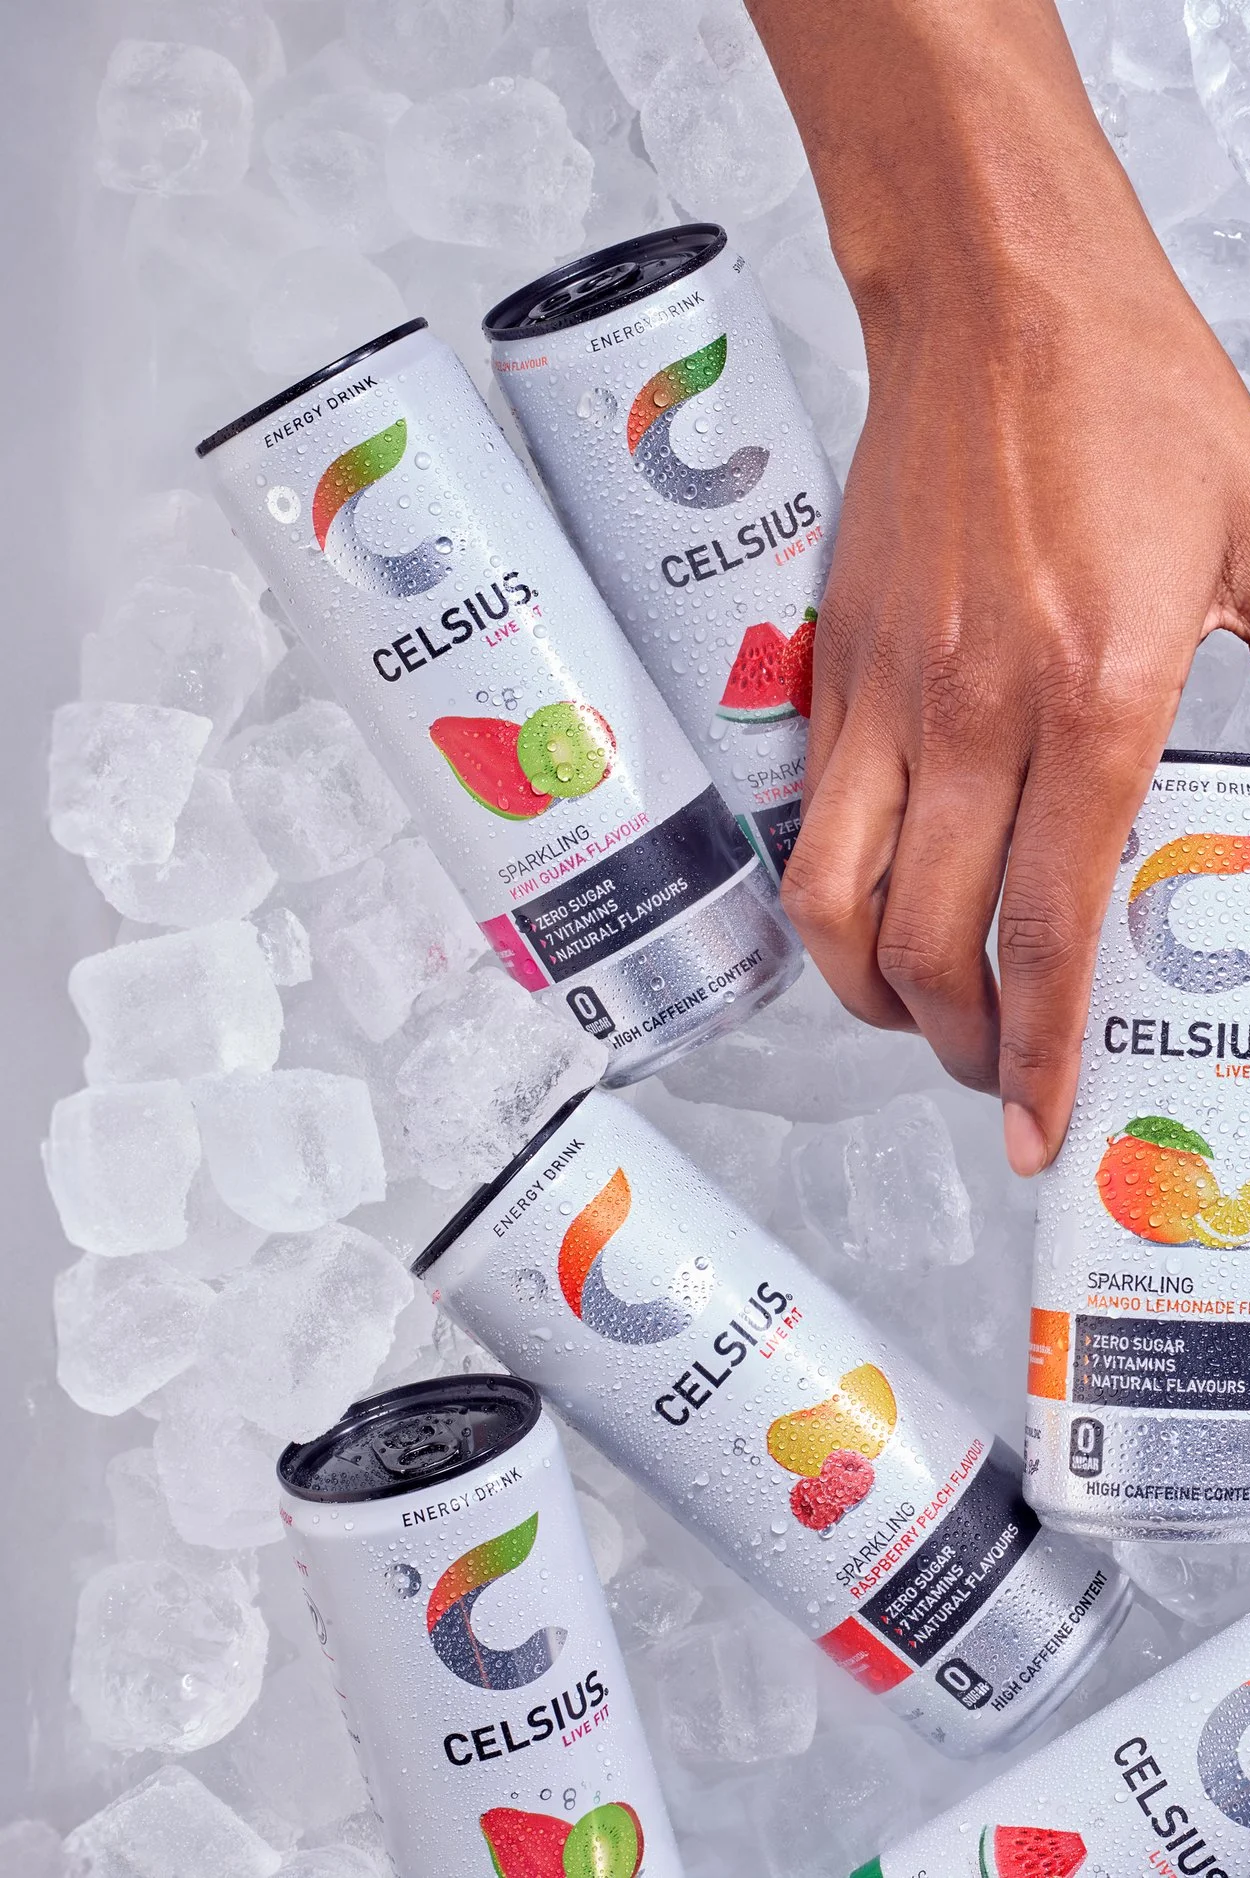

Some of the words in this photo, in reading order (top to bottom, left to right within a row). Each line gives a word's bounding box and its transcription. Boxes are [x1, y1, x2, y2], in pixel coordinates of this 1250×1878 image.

[591, 318, 652, 352] ENERGY
[660, 291, 704, 324] DRINK
[264, 405, 325, 449] ENERGY
[326, 375, 378, 411] DRINK
[661, 491, 816, 587] CELSIUS
[775, 542, 803, 566] LIVE
[805, 526, 823, 549] FIT
[372, 571, 533, 682] CELSIUS
[486, 620, 520, 646] LIVE
[1151, 779, 1210, 793] NERGY
[498, 824, 589, 884] SPARKLING
[509, 876, 538, 901] KIWI
[539, 852, 587, 886] GUAVA
[586, 812, 650, 859] FLAVOUR
[536, 901, 567, 930] ZERO
[566, 879, 615, 912] SUGAR
[553, 900, 618, 941] VITAMINS
[556, 927, 619, 964] NATURAL
[618, 877, 688, 929] FLAVOURS
[612, 1026, 643, 1049] HIGH
[643, 988, 708, 1035] CAFFEINE
[707, 949, 764, 992] CONTENT
[1216, 1063, 1250, 1078] LIVE
[493, 1180, 544, 1237] ENERGY
[544, 1138, 585, 1181] DRINK
[1088, 1272, 1193, 1294] SPARKLING
[1088, 1295, 1140, 1310] MANGO
[1147, 1298, 1235, 1314] LEMONADE
[654, 1281, 788, 1426] CELSIUS
[759, 1326, 788, 1360] LIVE
[784, 1306, 803, 1330] FIT
[1092, 1335, 1128, 1348] ZERO
[1133, 1338, 1184, 1352] SUGAR
[1092, 1375, 1161, 1391] NATURAL
[1167, 1379, 1245, 1393] FLAVOURS
[1102, 1357, 1175, 1371] VITAMINS
[401, 1493, 469, 1528] ENERGY
[475, 1468, 522, 1502] DRINK
[850, 1527, 920, 1600] RASPBERRY
[920, 1482, 953, 1529] PEACH
[951, 1438, 985, 1489] FLAVOUR
[1087, 1482, 1119, 1496] HIGH
[1125, 1485, 1199, 1500] CAFFEINE
[836, 1501, 916, 1586] SPARKLING
[886, 1585, 918, 1618] ZERO
[915, 1545, 957, 1592] SUGAR
[911, 1564, 964, 1623] VITAMINS
[915, 1587, 971, 1644] NATURAL
[964, 1523, 1019, 1591] FLAVOURS
[990, 1680, 1022, 1712] HIGH
[1019, 1620, 1074, 1684] CAFFEINE
[1070, 1570, 1107, 1625] CONTENT
[444, 1670, 606, 1766] CELSIUS
[963, 1682, 991, 1708] SUGAR
[563, 1721, 592, 1748] LIVE
[593, 1704, 610, 1725] FIT
